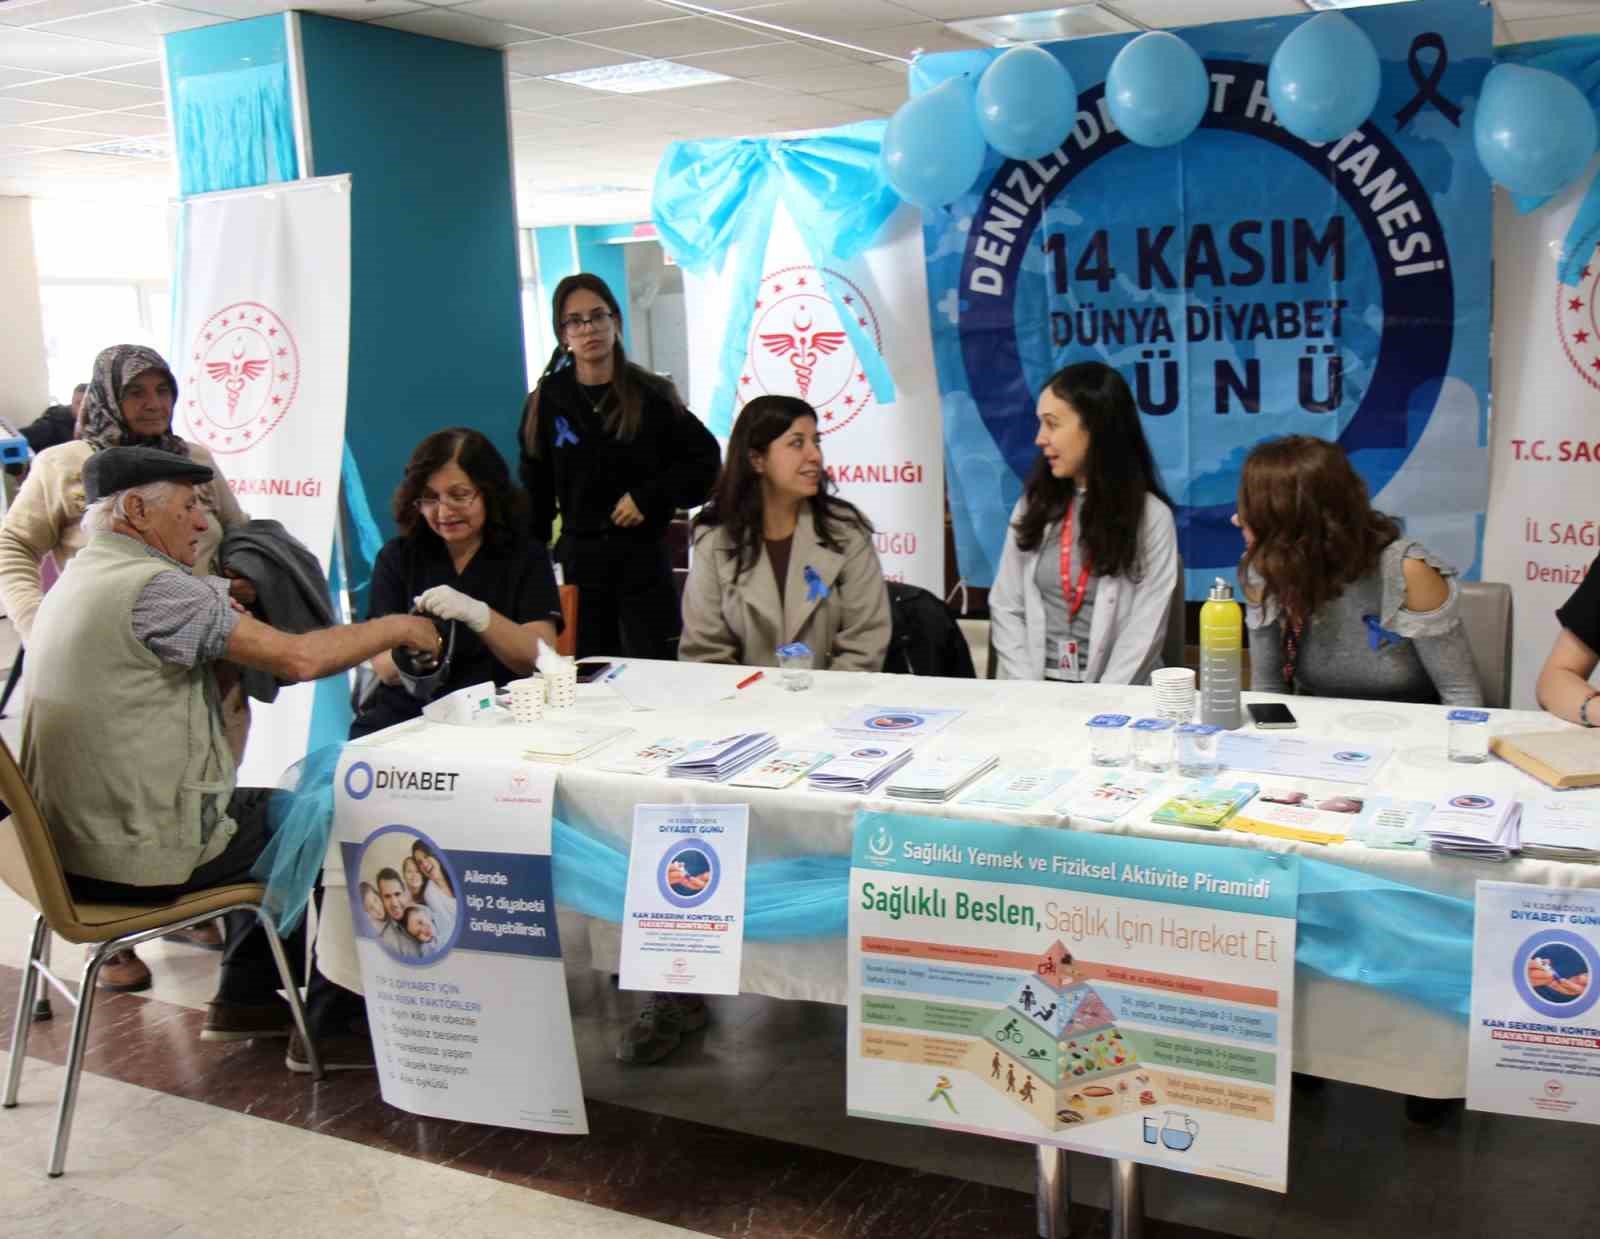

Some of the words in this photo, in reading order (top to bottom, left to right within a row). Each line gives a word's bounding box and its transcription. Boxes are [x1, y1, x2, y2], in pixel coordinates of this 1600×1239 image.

[1041, 229, 1116, 295] 14
[1136, 215, 1346, 290] KASIM
[1050, 302, 1175, 347] DÜNYA
[1185, 296, 1348, 343] DİYABET
[1134, 345, 1344, 417] ÜNÜ
[826, 460, 924, 484] AKANLIĞI
[1511, 440, 1552, 462] T.C.
[375, 766, 460, 792] DİYABET
[903, 840, 963, 865] Sağlıklı
[967, 847, 1024, 869] Yemek
[1028, 857, 1048, 872] ve
[1052, 854, 1117, 881] Fiziksel
[1121, 864, 1188, 889] Aktivite
[1193, 872, 1271, 899] Piramidi
[485, 895, 494, 910] 2
[861, 881, 946, 921] Sağlıklı
[955, 891, 1042, 932] Beslen,
[1044, 901, 1109, 943] Sağlık
[1159, 917, 1249, 958] Hareket
[1254, 929, 1278, 963] Et
